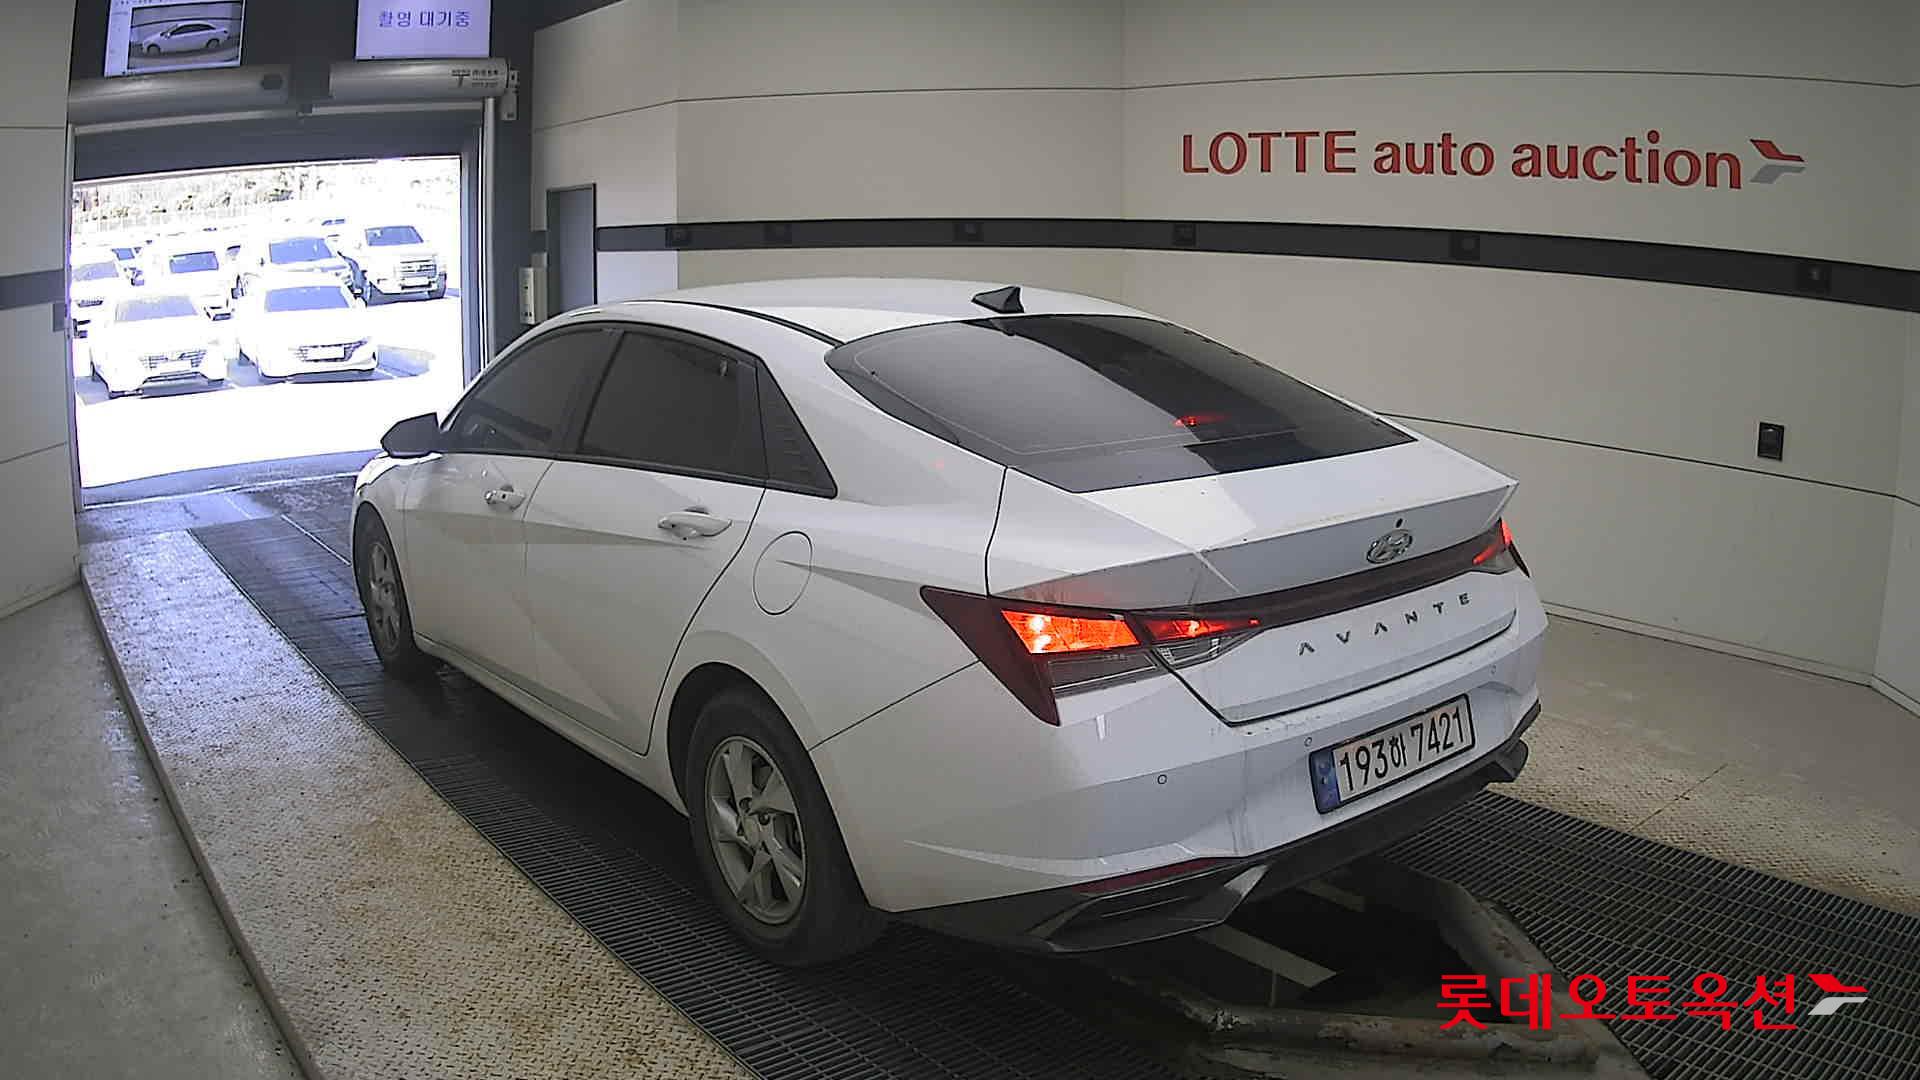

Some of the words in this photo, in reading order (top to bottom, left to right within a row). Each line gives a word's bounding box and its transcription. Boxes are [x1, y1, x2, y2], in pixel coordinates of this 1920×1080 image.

[419, 10, 470, 28] 대기중
[1182, 130, 1356, 175] LOTTE
[1373, 132, 1495, 176] auto
[1511, 129, 1742, 189] auction
[1298, 592, 1471, 656] AVANTE
[1339, 731, 1408, 792] 193하
[1409, 706, 1465, 763] 7421
